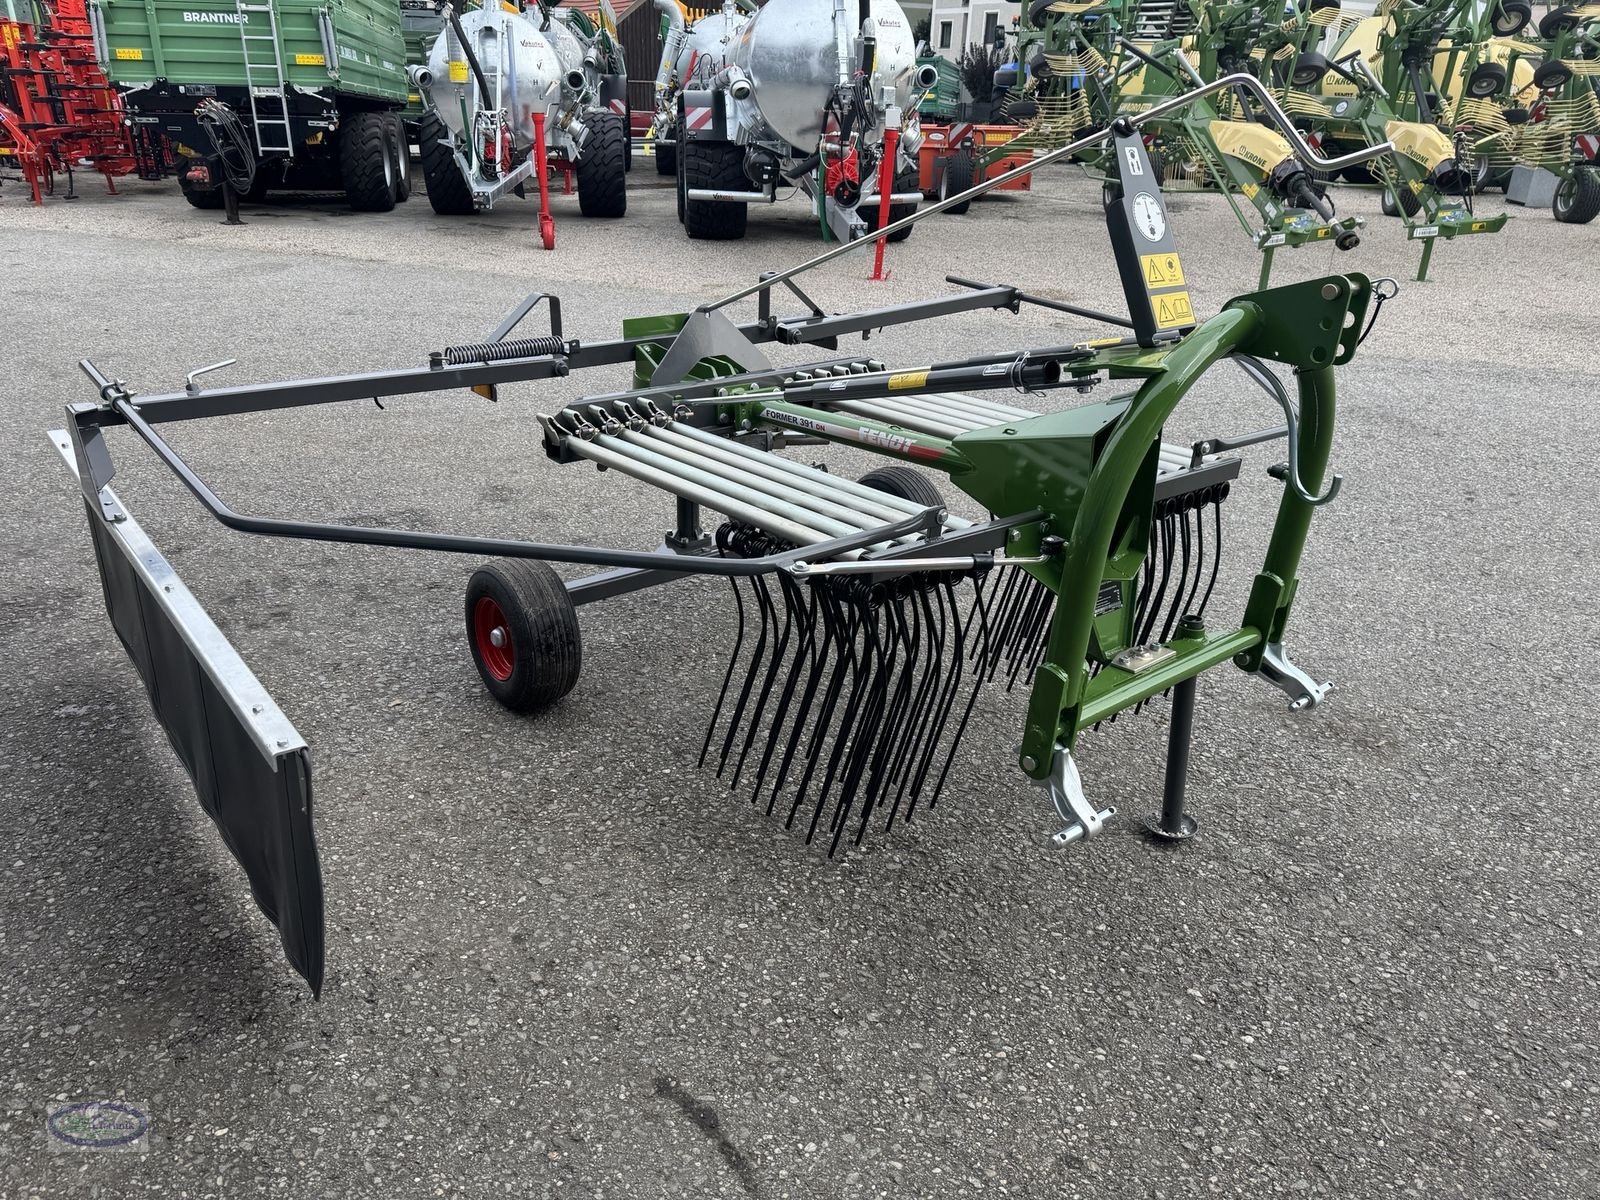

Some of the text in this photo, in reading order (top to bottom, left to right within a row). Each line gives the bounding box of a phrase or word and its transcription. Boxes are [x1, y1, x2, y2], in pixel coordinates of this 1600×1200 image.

[183, 12, 249, 24] BRANTNER
[1244, 149, 1268, 168] KRONE
[1409, 150, 1429, 165] KRONE
[766, 410, 798, 425] FORMER
[799, 417, 814, 429] 391
[858, 427, 917, 453] FENDT
